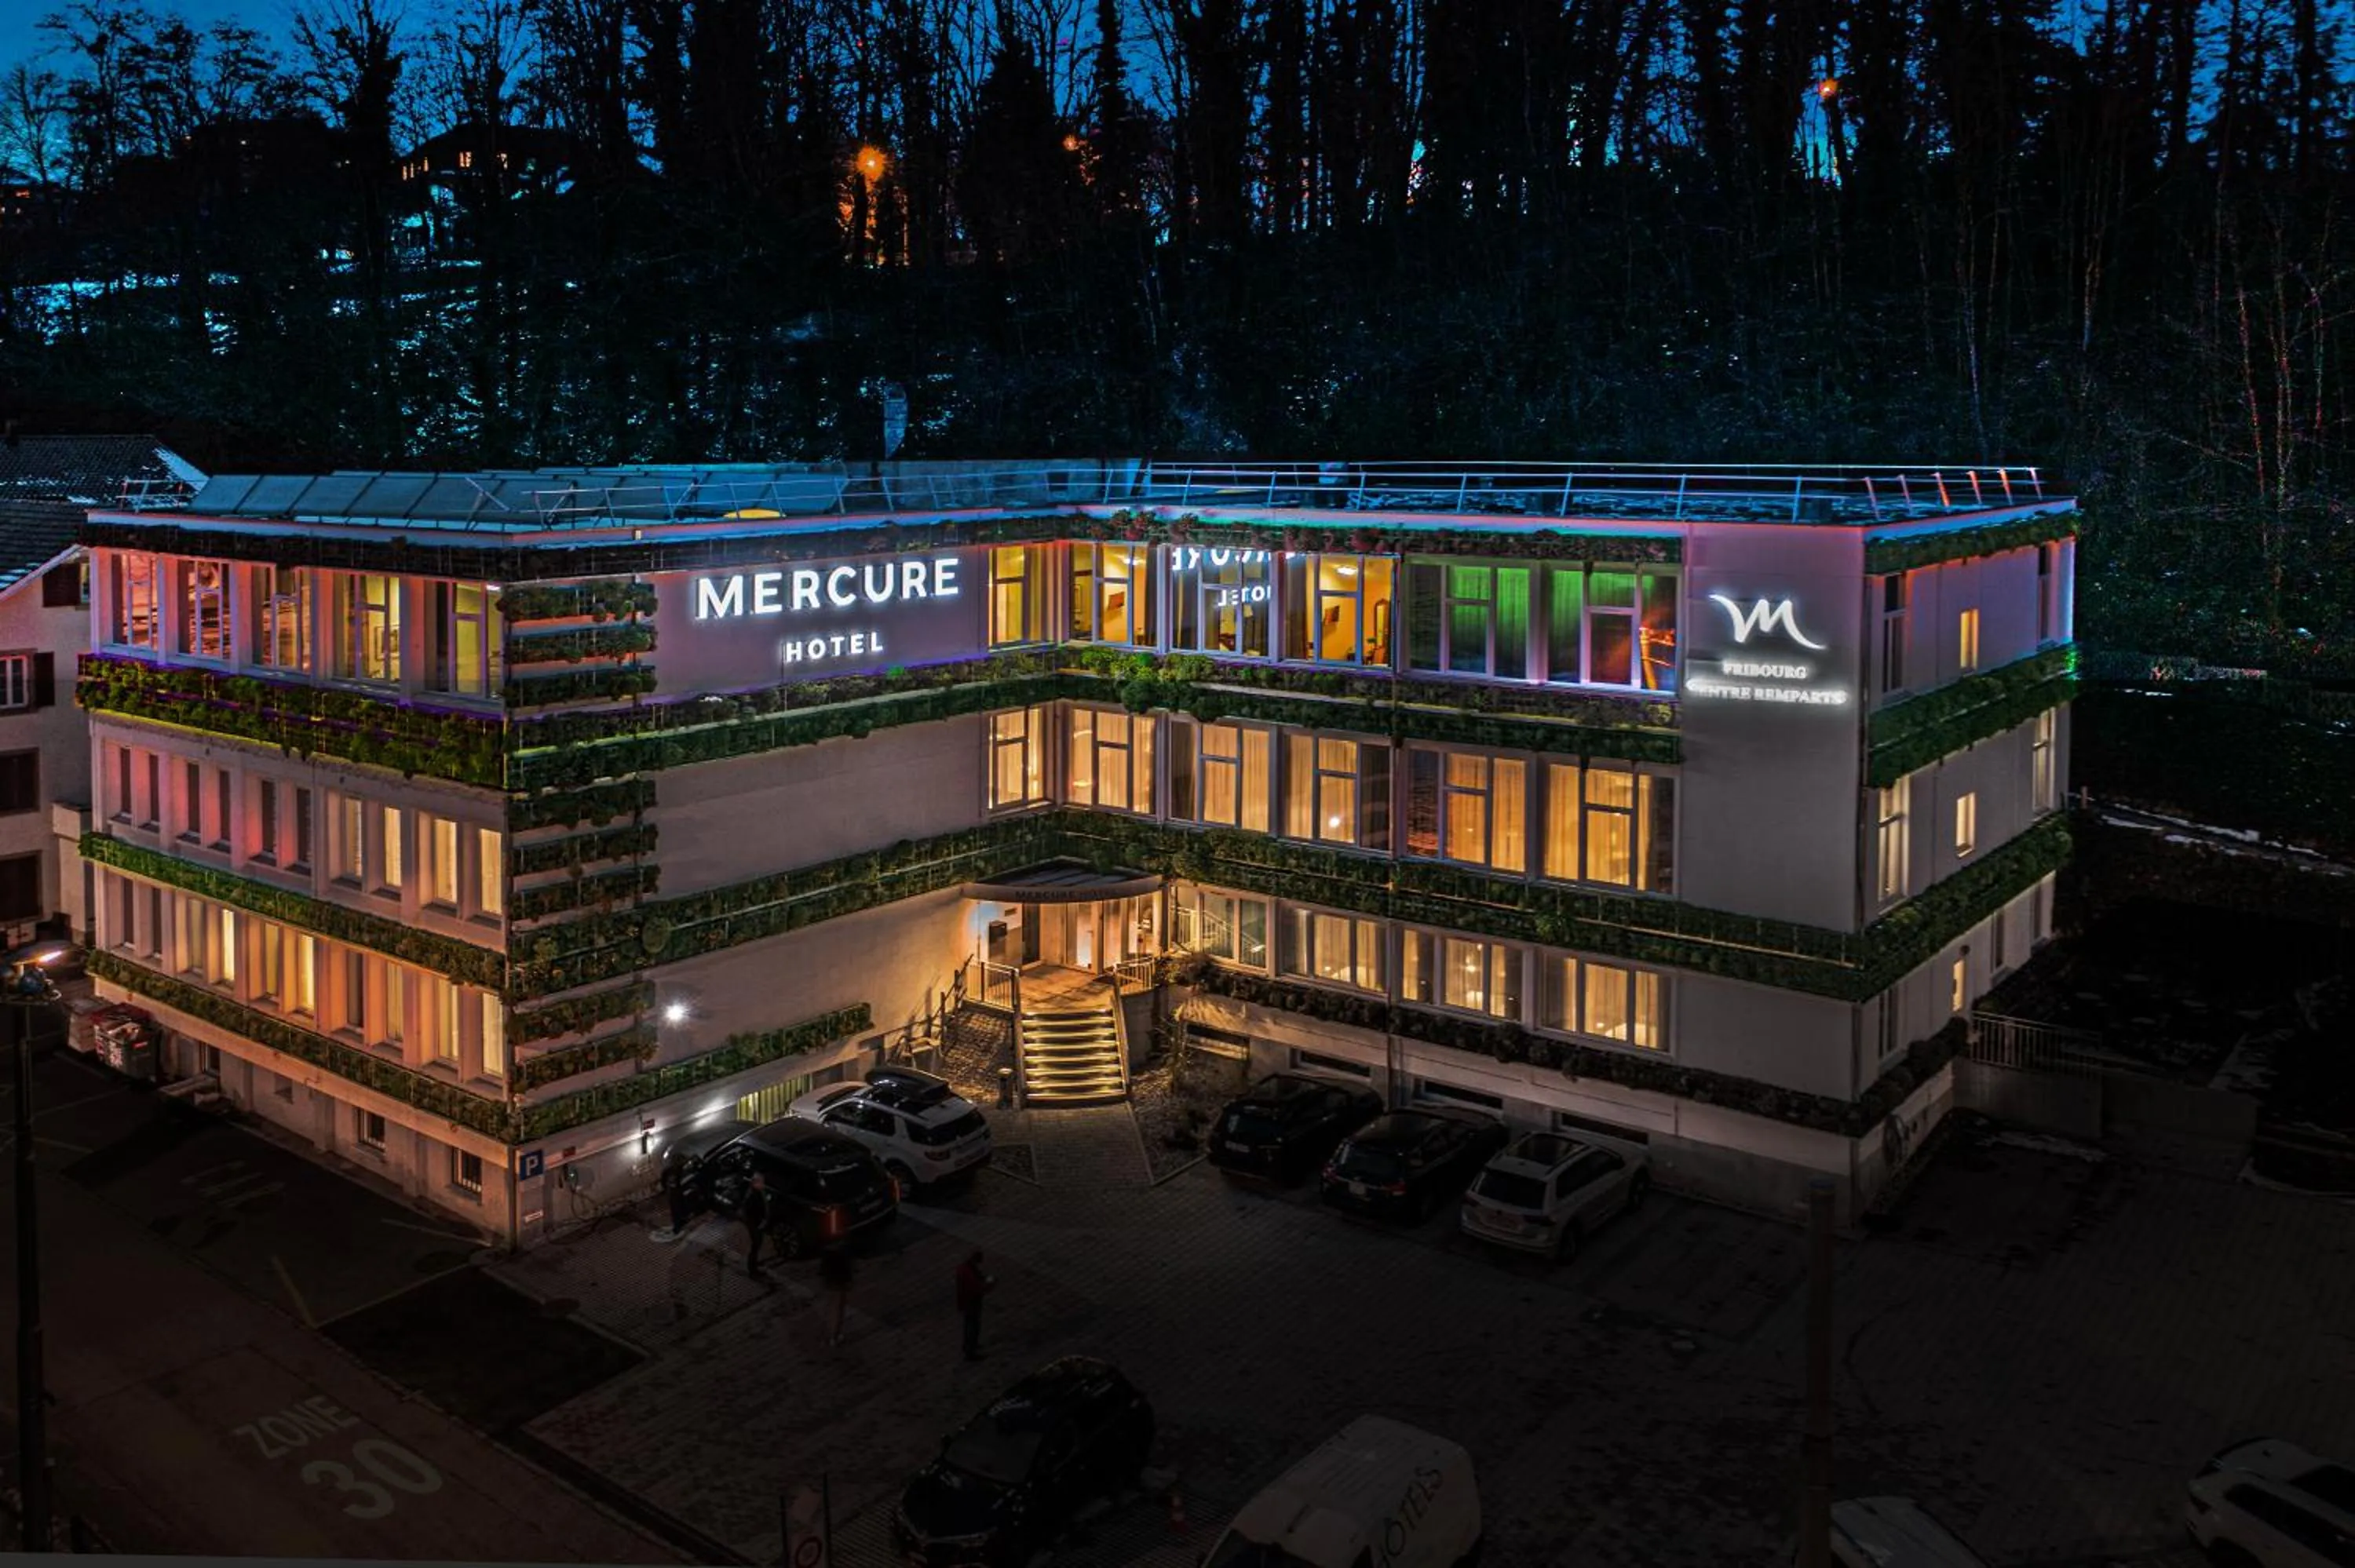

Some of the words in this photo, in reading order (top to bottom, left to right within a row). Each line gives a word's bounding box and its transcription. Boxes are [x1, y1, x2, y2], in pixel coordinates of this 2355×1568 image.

[697, 558, 959, 619] MERCURE
[786, 632, 884, 662] HOTEL
[1723, 662, 1807, 680] FRIBOURG
[1754, 687, 1847, 705] REMPARTS
[525, 1154, 539, 1176] P
[232, 1395, 360, 1459] ZONE
[301, 1439, 442, 1519] 30
